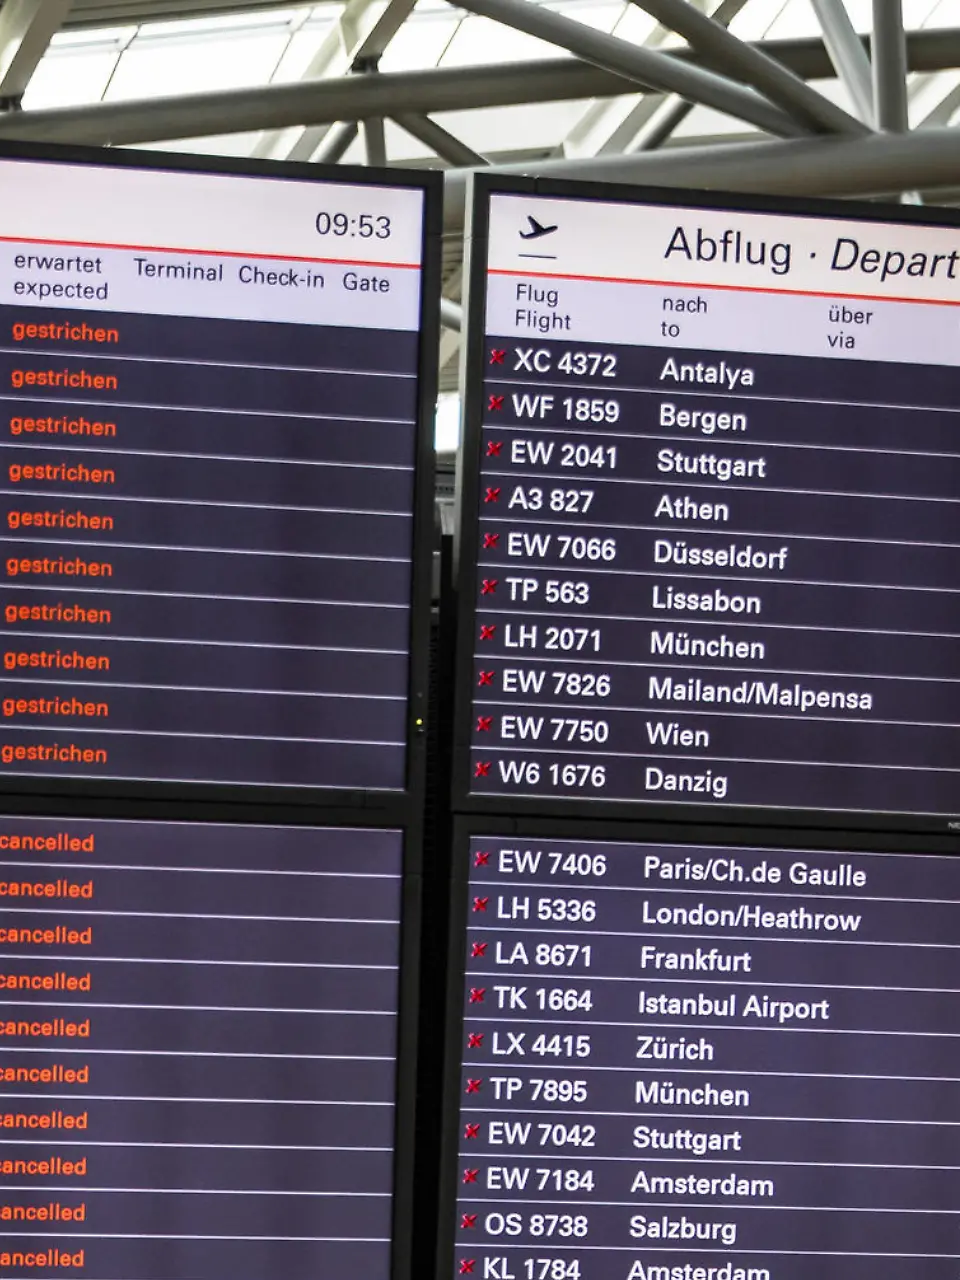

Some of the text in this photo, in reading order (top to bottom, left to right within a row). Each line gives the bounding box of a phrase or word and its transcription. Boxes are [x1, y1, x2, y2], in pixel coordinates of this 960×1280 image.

[315, 211, 391, 239] 09:53
[664, 226, 791, 275] Abflug
[13, 281, 108, 301] expected
[14, 254, 102, 274] erwartet
[133, 257, 223, 282] Terminal
[238, 264, 325, 288] Check-in
[342, 271, 390, 293] Gate
[515, 282, 874, 325] Flug nach über
[12, 321, 119, 342] gestrichen
[514, 308, 856, 349] Flight to via
[11, 369, 118, 390] gestrichen
[513, 347, 755, 390] XC 4372 Antalya
[8, 463, 115, 483] gestrichen
[511, 439, 767, 482] EW 2041 Stuttgart
[6, 557, 113, 577] gestrichen
[507, 531, 789, 570] EW 7066 Düsseldorf
[4, 650, 110, 670] gestrichen
[504, 623, 765, 660] LH 2071 München
[502, 668, 873, 712] EW 7826 Mailand/Malpensa
[1, 743, 107, 763] gestrichen
[498, 759, 728, 799] W6 1676 Danzig
[498, 849, 867, 887] EW 7406 Paris/Ch.de Gaulle
[492, 985, 830, 1024] TK 1664 Istanbul Airport
[488, 1120, 742, 1156] EW 7042 Stuttgart
[484, 1212, 737, 1246] OS 8738 Salzburg
